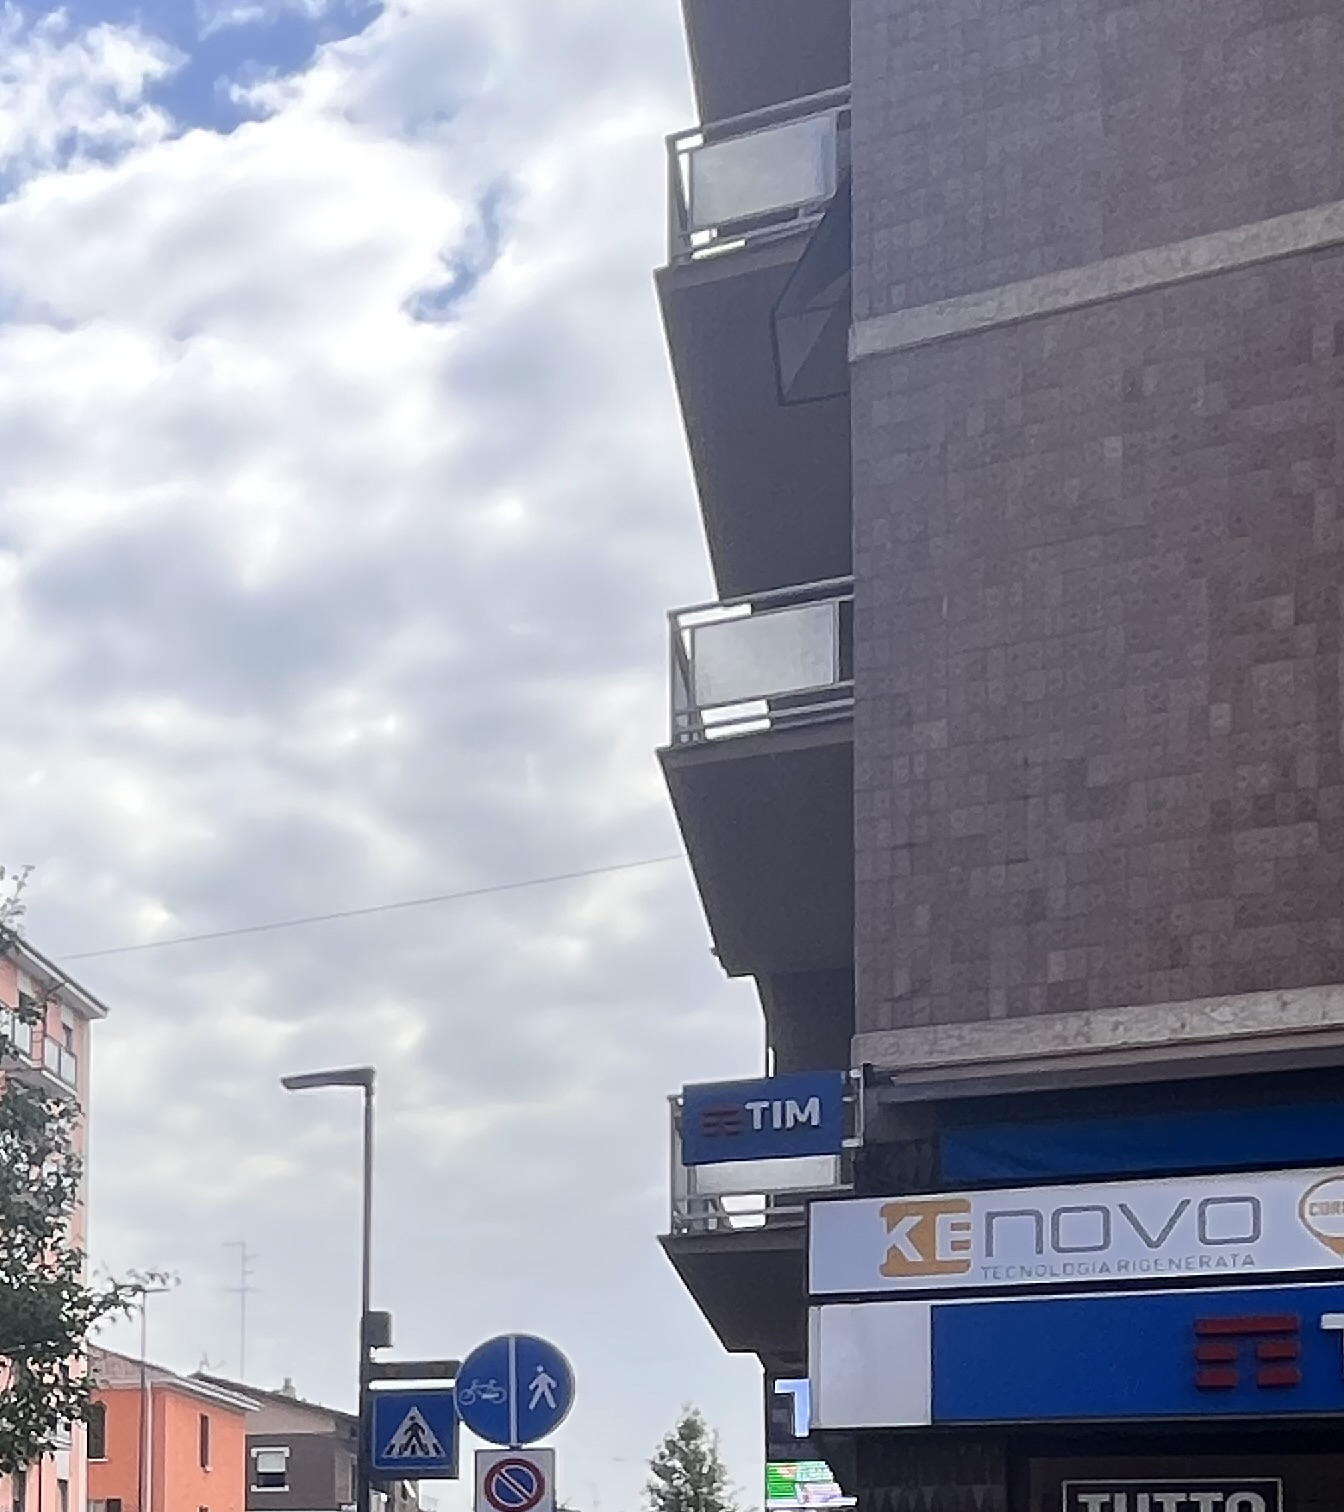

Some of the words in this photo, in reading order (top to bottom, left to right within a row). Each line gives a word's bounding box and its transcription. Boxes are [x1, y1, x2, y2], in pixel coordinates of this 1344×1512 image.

[744, 1096, 820, 1131] TIM
[1308, 1200, 1344, 1217] COR
[980, 1261, 1112, 1281] TECNOLOGIA
[1116, 1253, 1256, 1273] RIGENERATA
